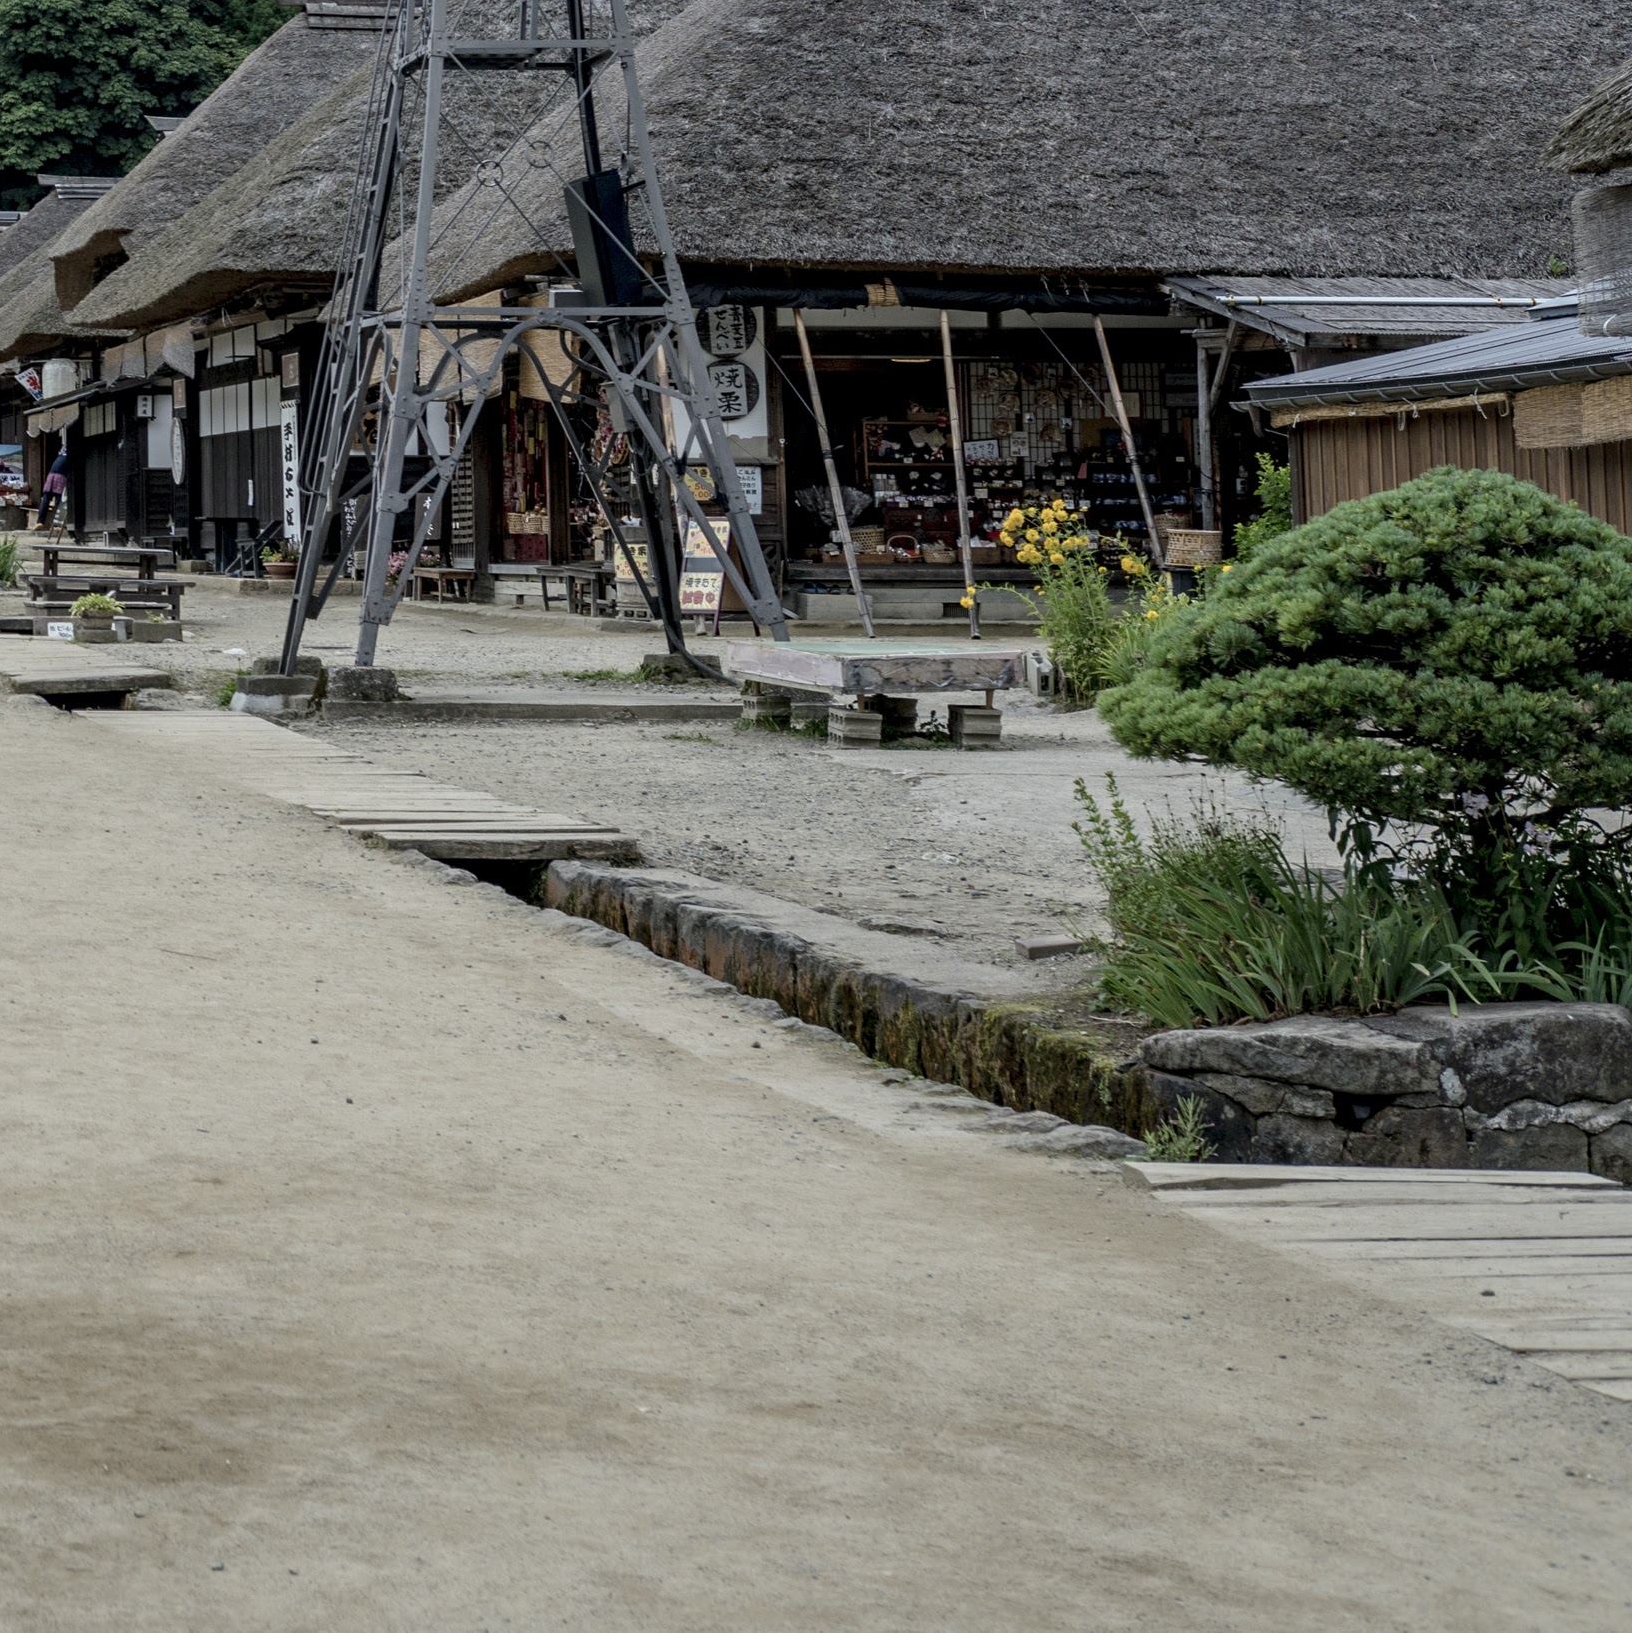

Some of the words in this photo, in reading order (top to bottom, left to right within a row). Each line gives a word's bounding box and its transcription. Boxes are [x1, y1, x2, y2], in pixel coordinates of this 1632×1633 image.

[714, 309, 730, 351] せんべい
[714, 367, 743, 414] 焼栗
